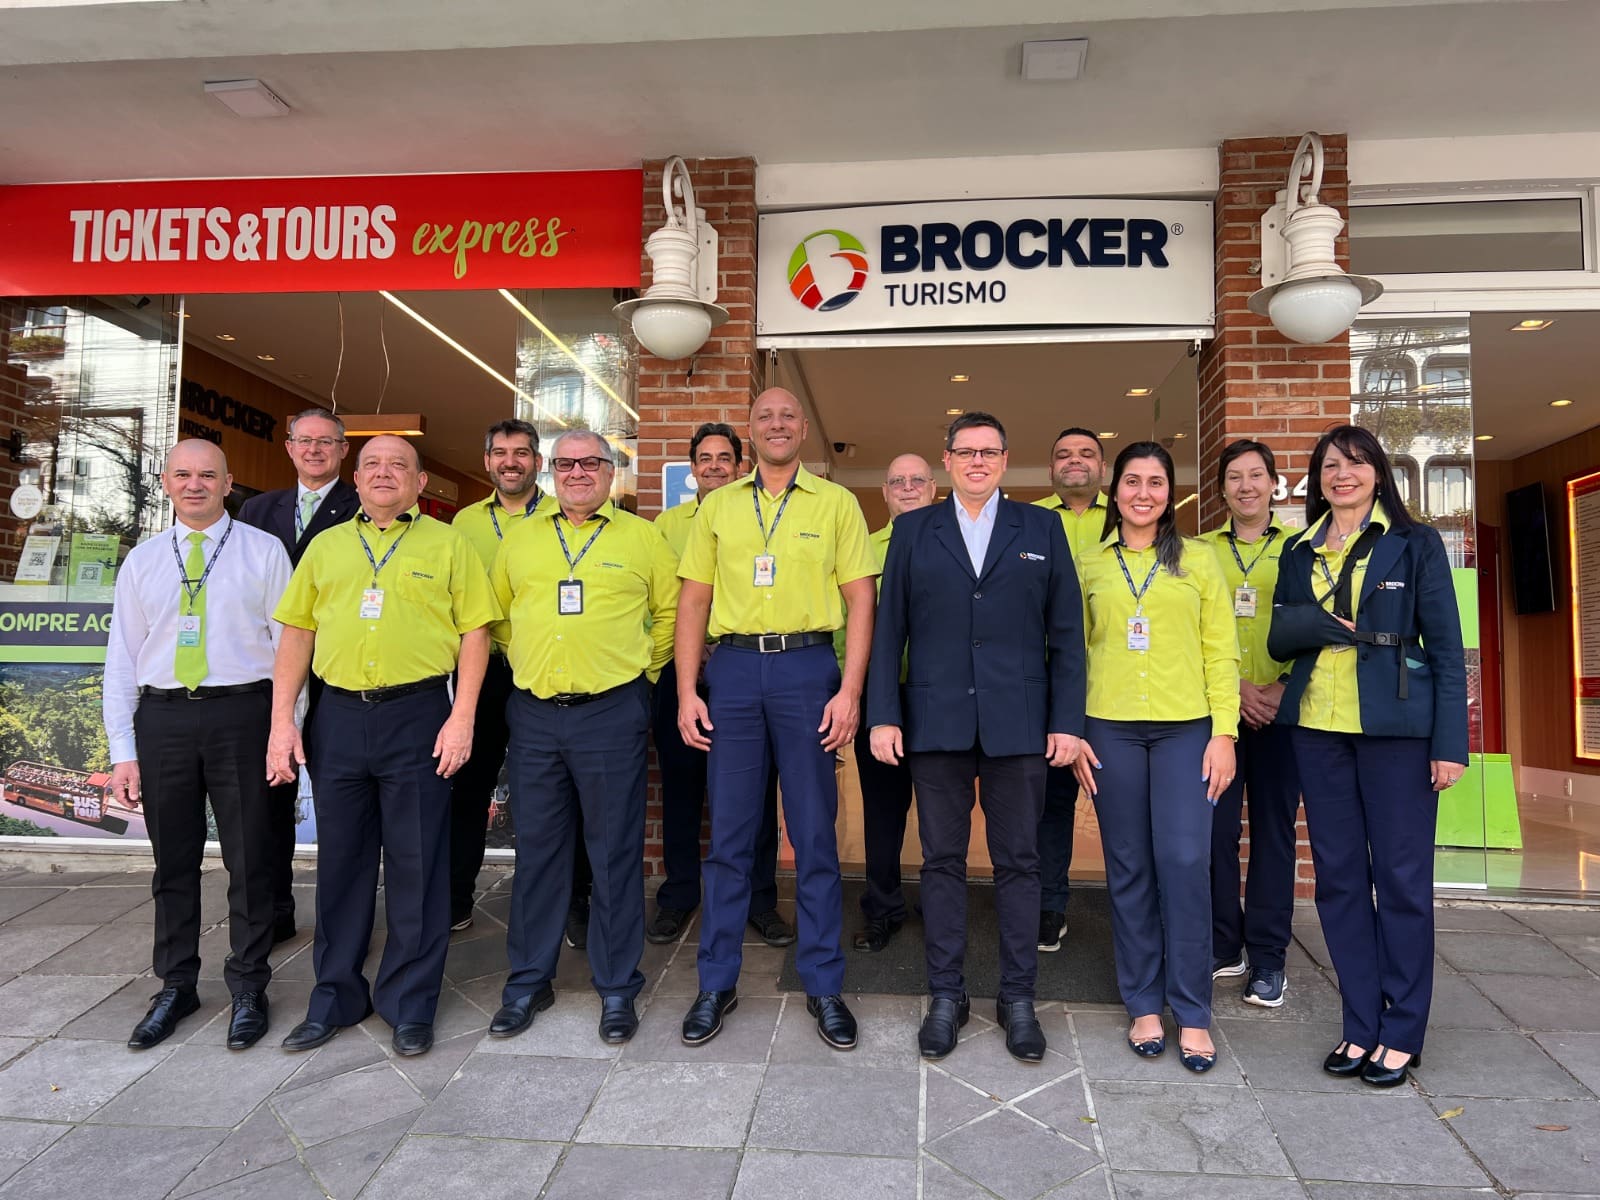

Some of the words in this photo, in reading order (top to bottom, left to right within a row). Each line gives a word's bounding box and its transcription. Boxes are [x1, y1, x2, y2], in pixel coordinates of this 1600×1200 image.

[70, 205, 397, 262] TICKETS&TOURS
[412, 217, 569, 280] express
[880, 217, 1169, 274] BROCKER
[884, 280, 1006, 307] TURISMO
[73, 795, 101, 810] BUS
